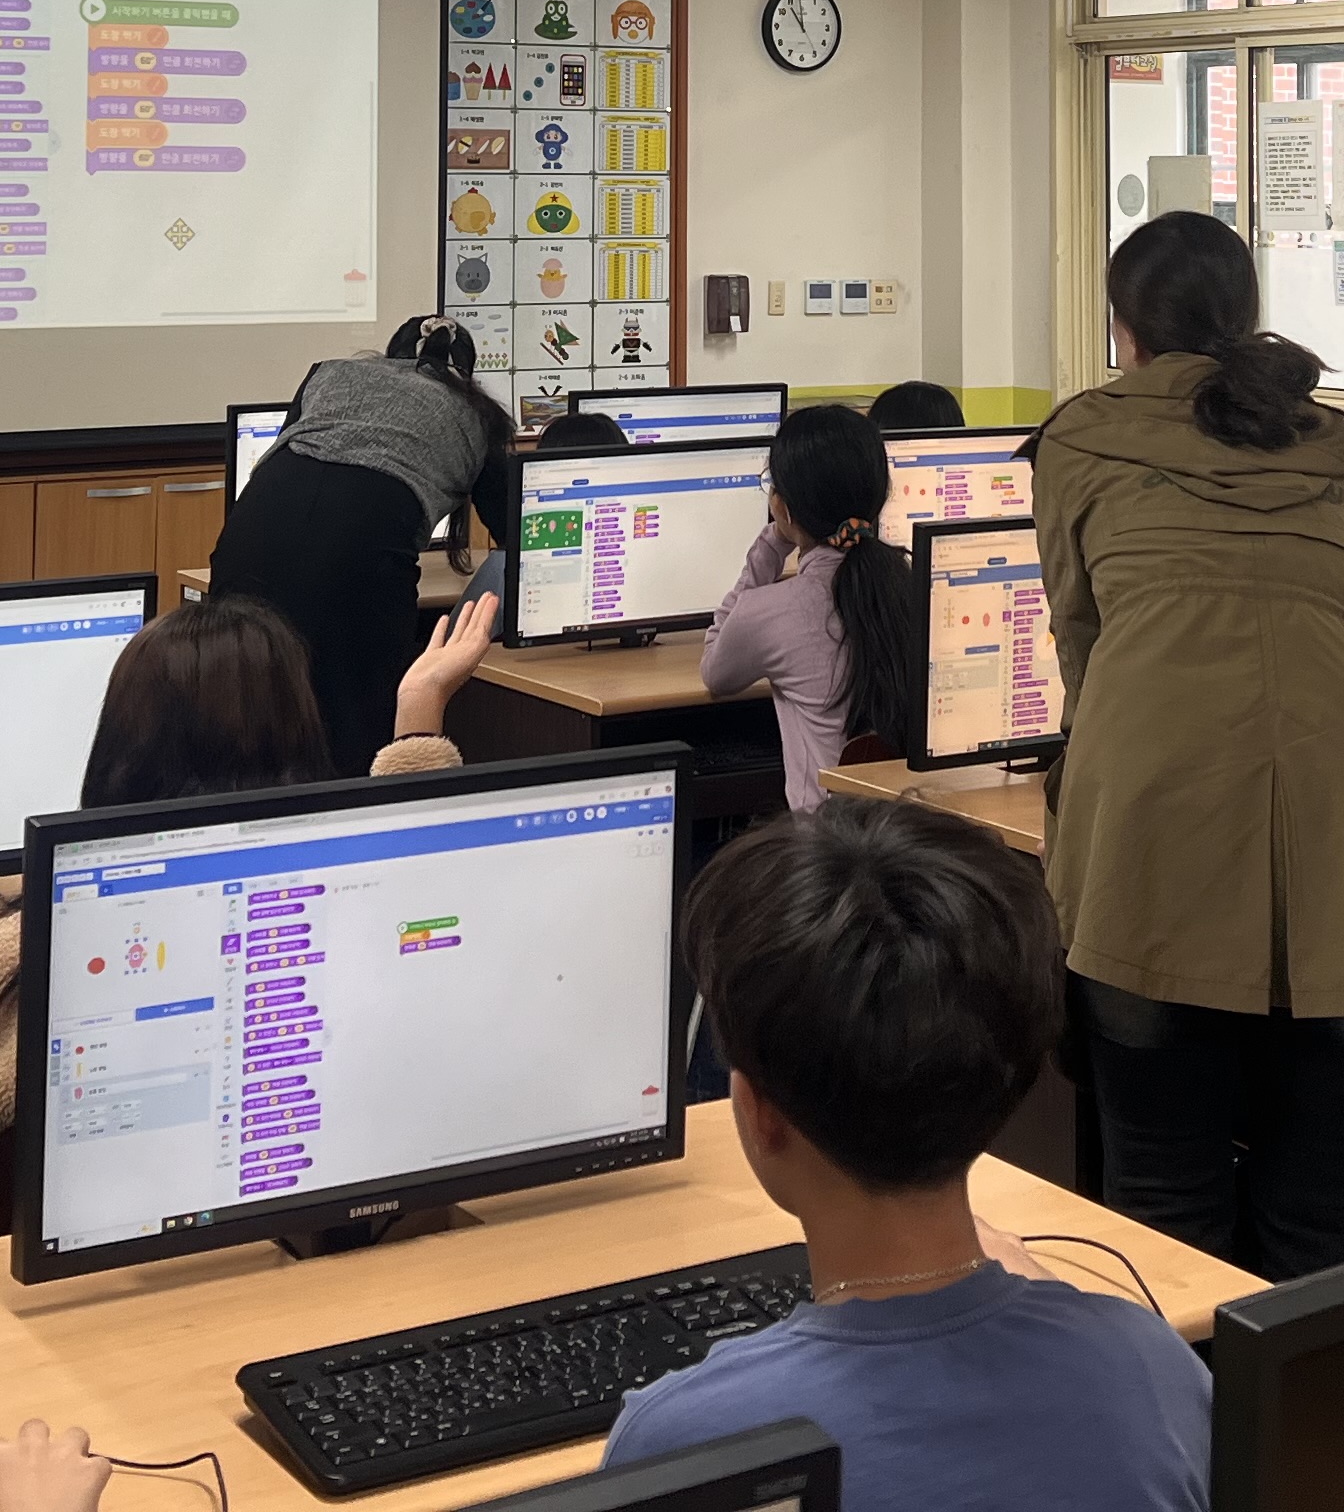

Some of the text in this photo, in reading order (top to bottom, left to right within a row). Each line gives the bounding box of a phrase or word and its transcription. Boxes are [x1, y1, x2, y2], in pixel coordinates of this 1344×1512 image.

[112, 6, 231, 20] 시작하기 버튼을 클릭했을 때
[778, 8, 787, 16] 10
[821, 8, 826, 16] 2
[774, 22, 780, 30] 9
[825, 24, 830, 32] 3
[778, 39, 784, 47] 8
[821, 39, 827, 47] 4
[787, 49, 794, 57] 7
[812, 50, 817, 58] 5
[799, 54, 805, 62] 6
[184, 57, 221, 69] 회전하기
[349, 1199, 400, 1219] SAMSUNG
